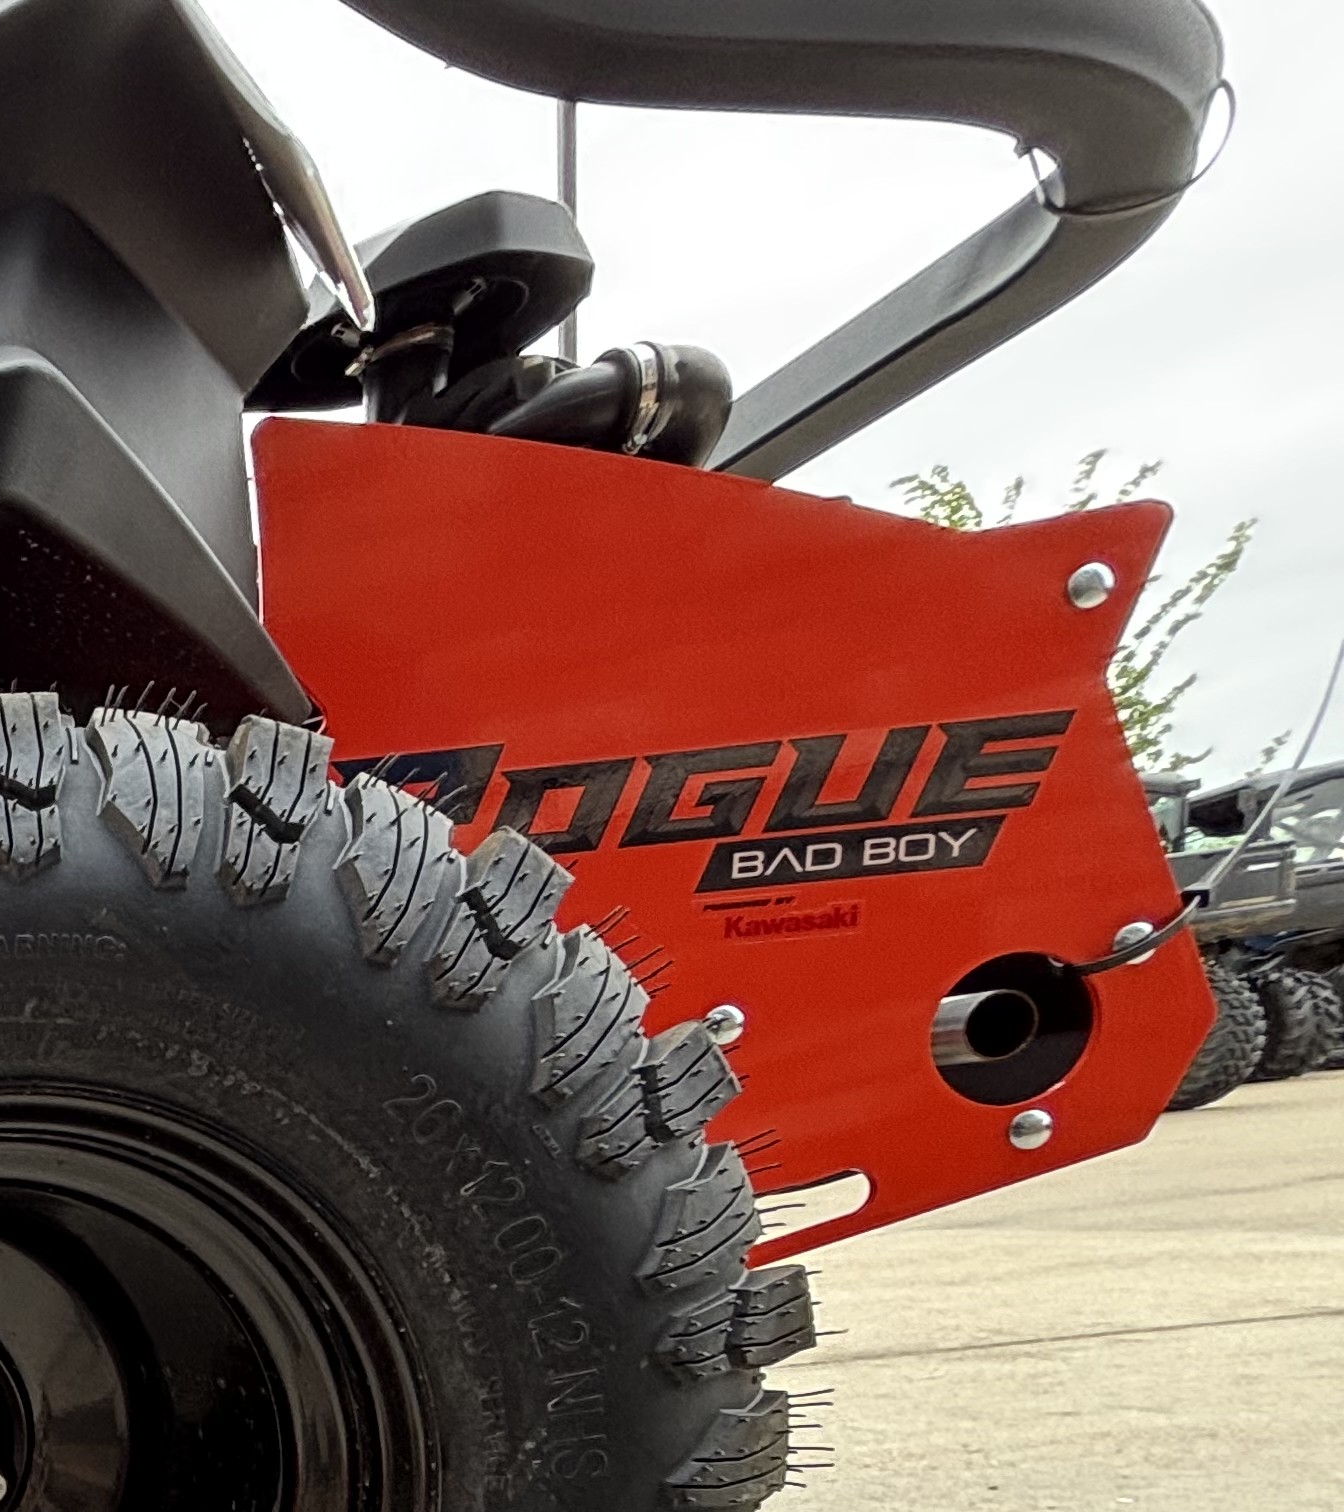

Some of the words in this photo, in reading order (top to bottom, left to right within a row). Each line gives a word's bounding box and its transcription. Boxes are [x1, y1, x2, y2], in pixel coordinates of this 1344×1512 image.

[731, 842, 843, 879] BAD
[863, 828, 977, 866] BOY
[723, 904, 859, 940] Kawasaki
